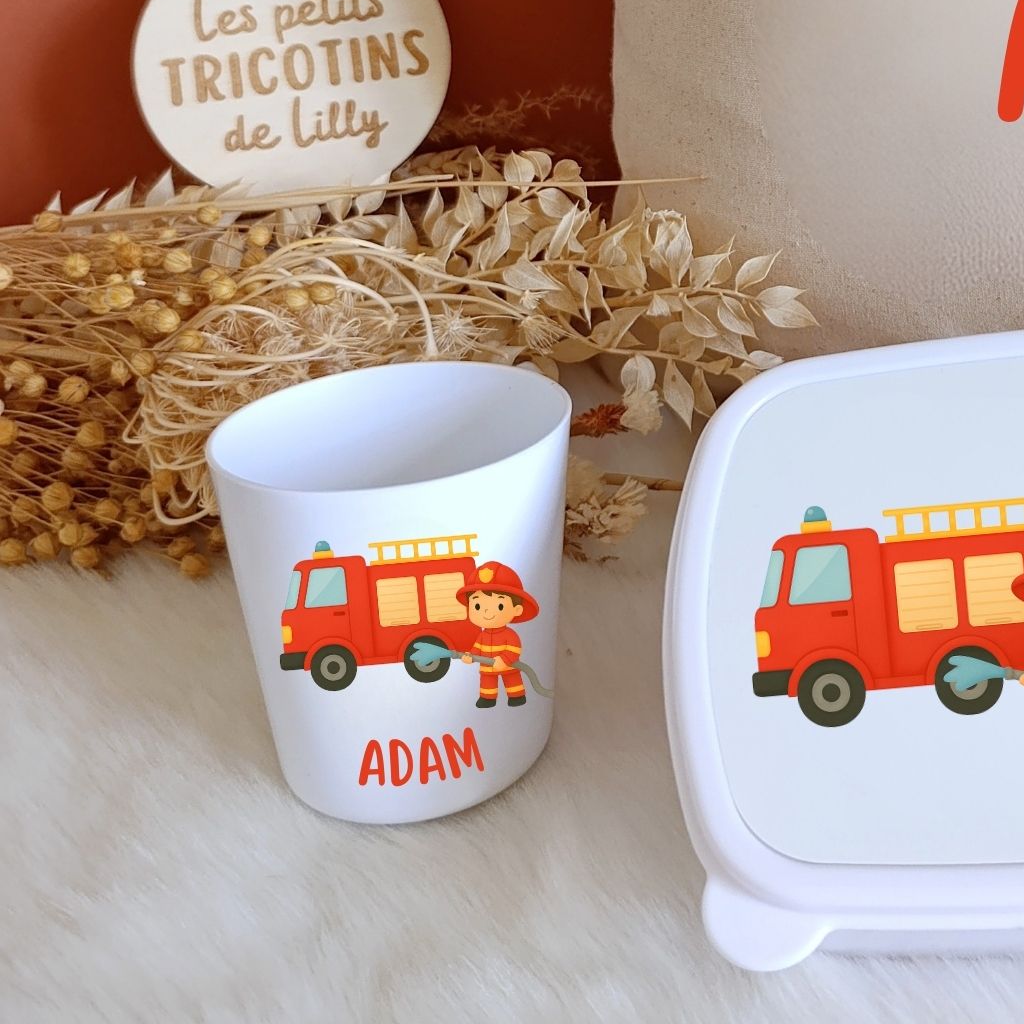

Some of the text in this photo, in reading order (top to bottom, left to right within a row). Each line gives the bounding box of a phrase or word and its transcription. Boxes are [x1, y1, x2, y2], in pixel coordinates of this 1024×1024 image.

[160, 29, 430, 107] TRICOTINS
[224, 96, 389, 152] de Lilly
[358, 727, 485, 787] ADAM
